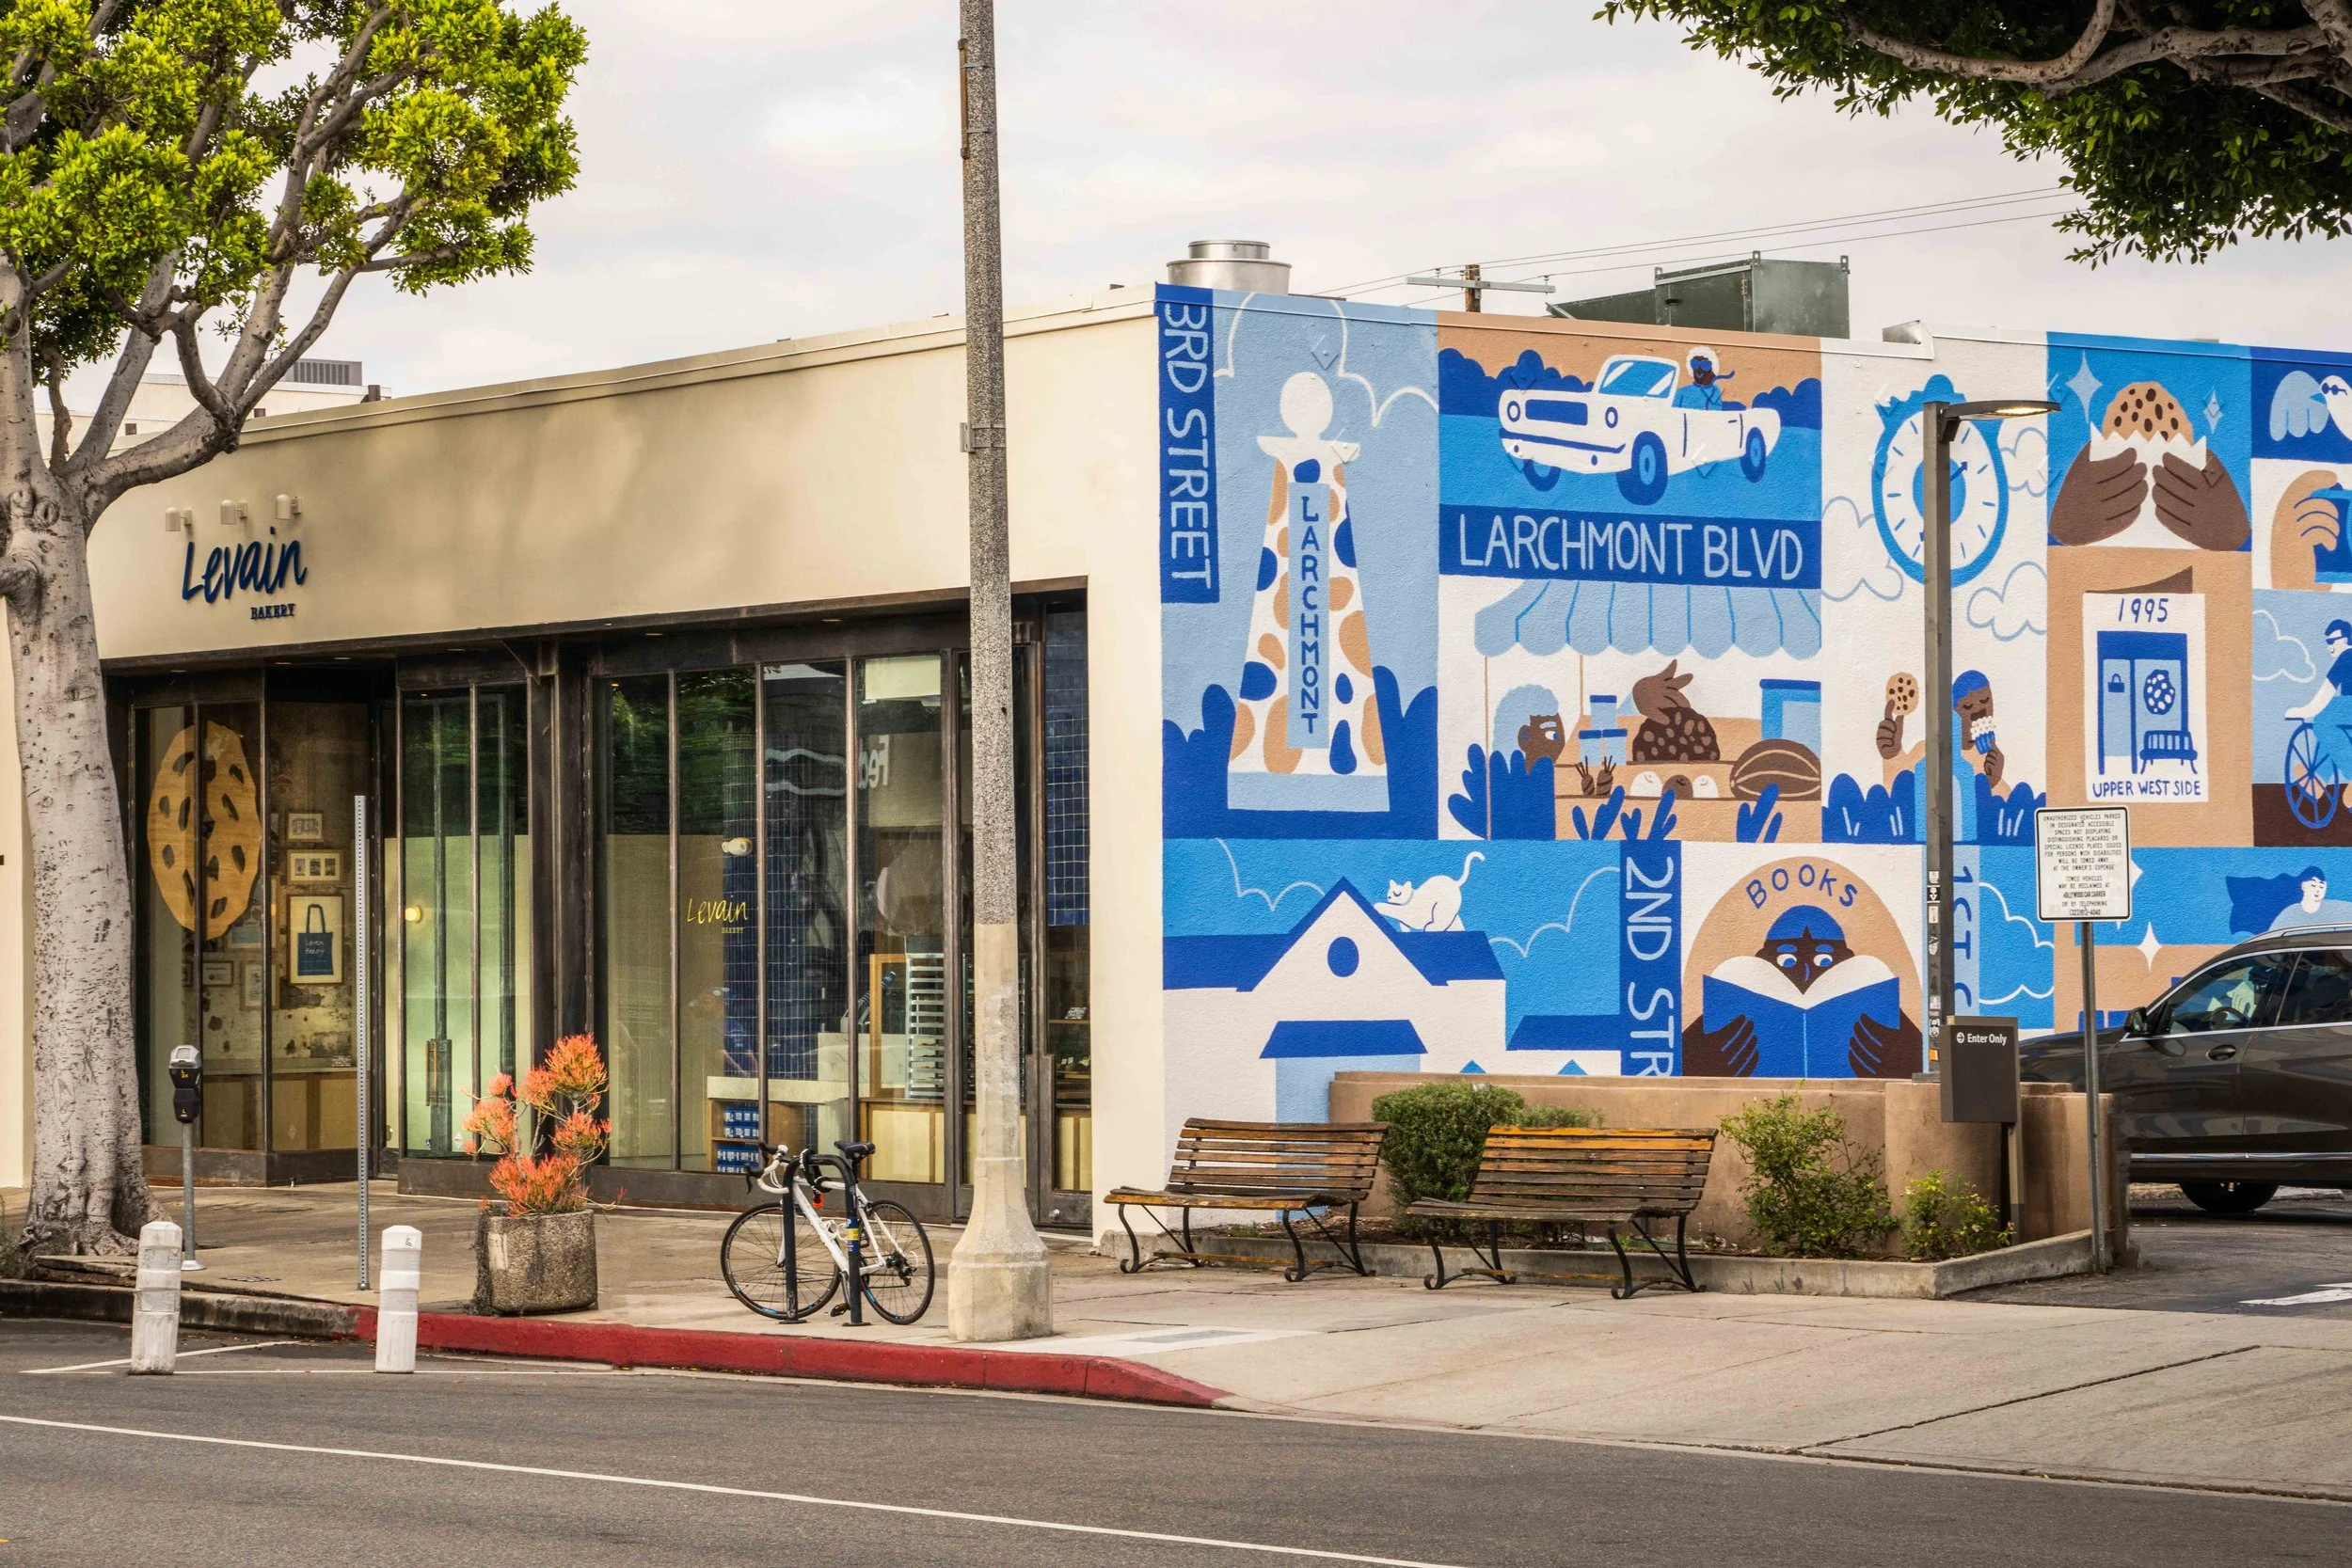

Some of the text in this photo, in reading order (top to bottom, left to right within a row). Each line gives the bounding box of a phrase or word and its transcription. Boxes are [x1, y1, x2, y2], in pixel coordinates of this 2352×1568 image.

[1165, 303, 1211, 589] 3RD STREET
[182, 526, 308, 604] Levain
[1460, 514, 1803, 580] LARCHMONT BLVD
[250, 603, 295, 620] BAKERY
[1300, 496, 1319, 734] LARCHMONT
[2118, 598, 2169, 623] 1995
[2093, 779, 2201, 798] UPPER WEST SIDE
[1746, 863, 1858, 909] BOOKS
[687, 895, 748, 924] Levain
[1626, 856, 1674, 1076] 2ND STR
[1967, 1033, 2007, 1046] Enter Only
